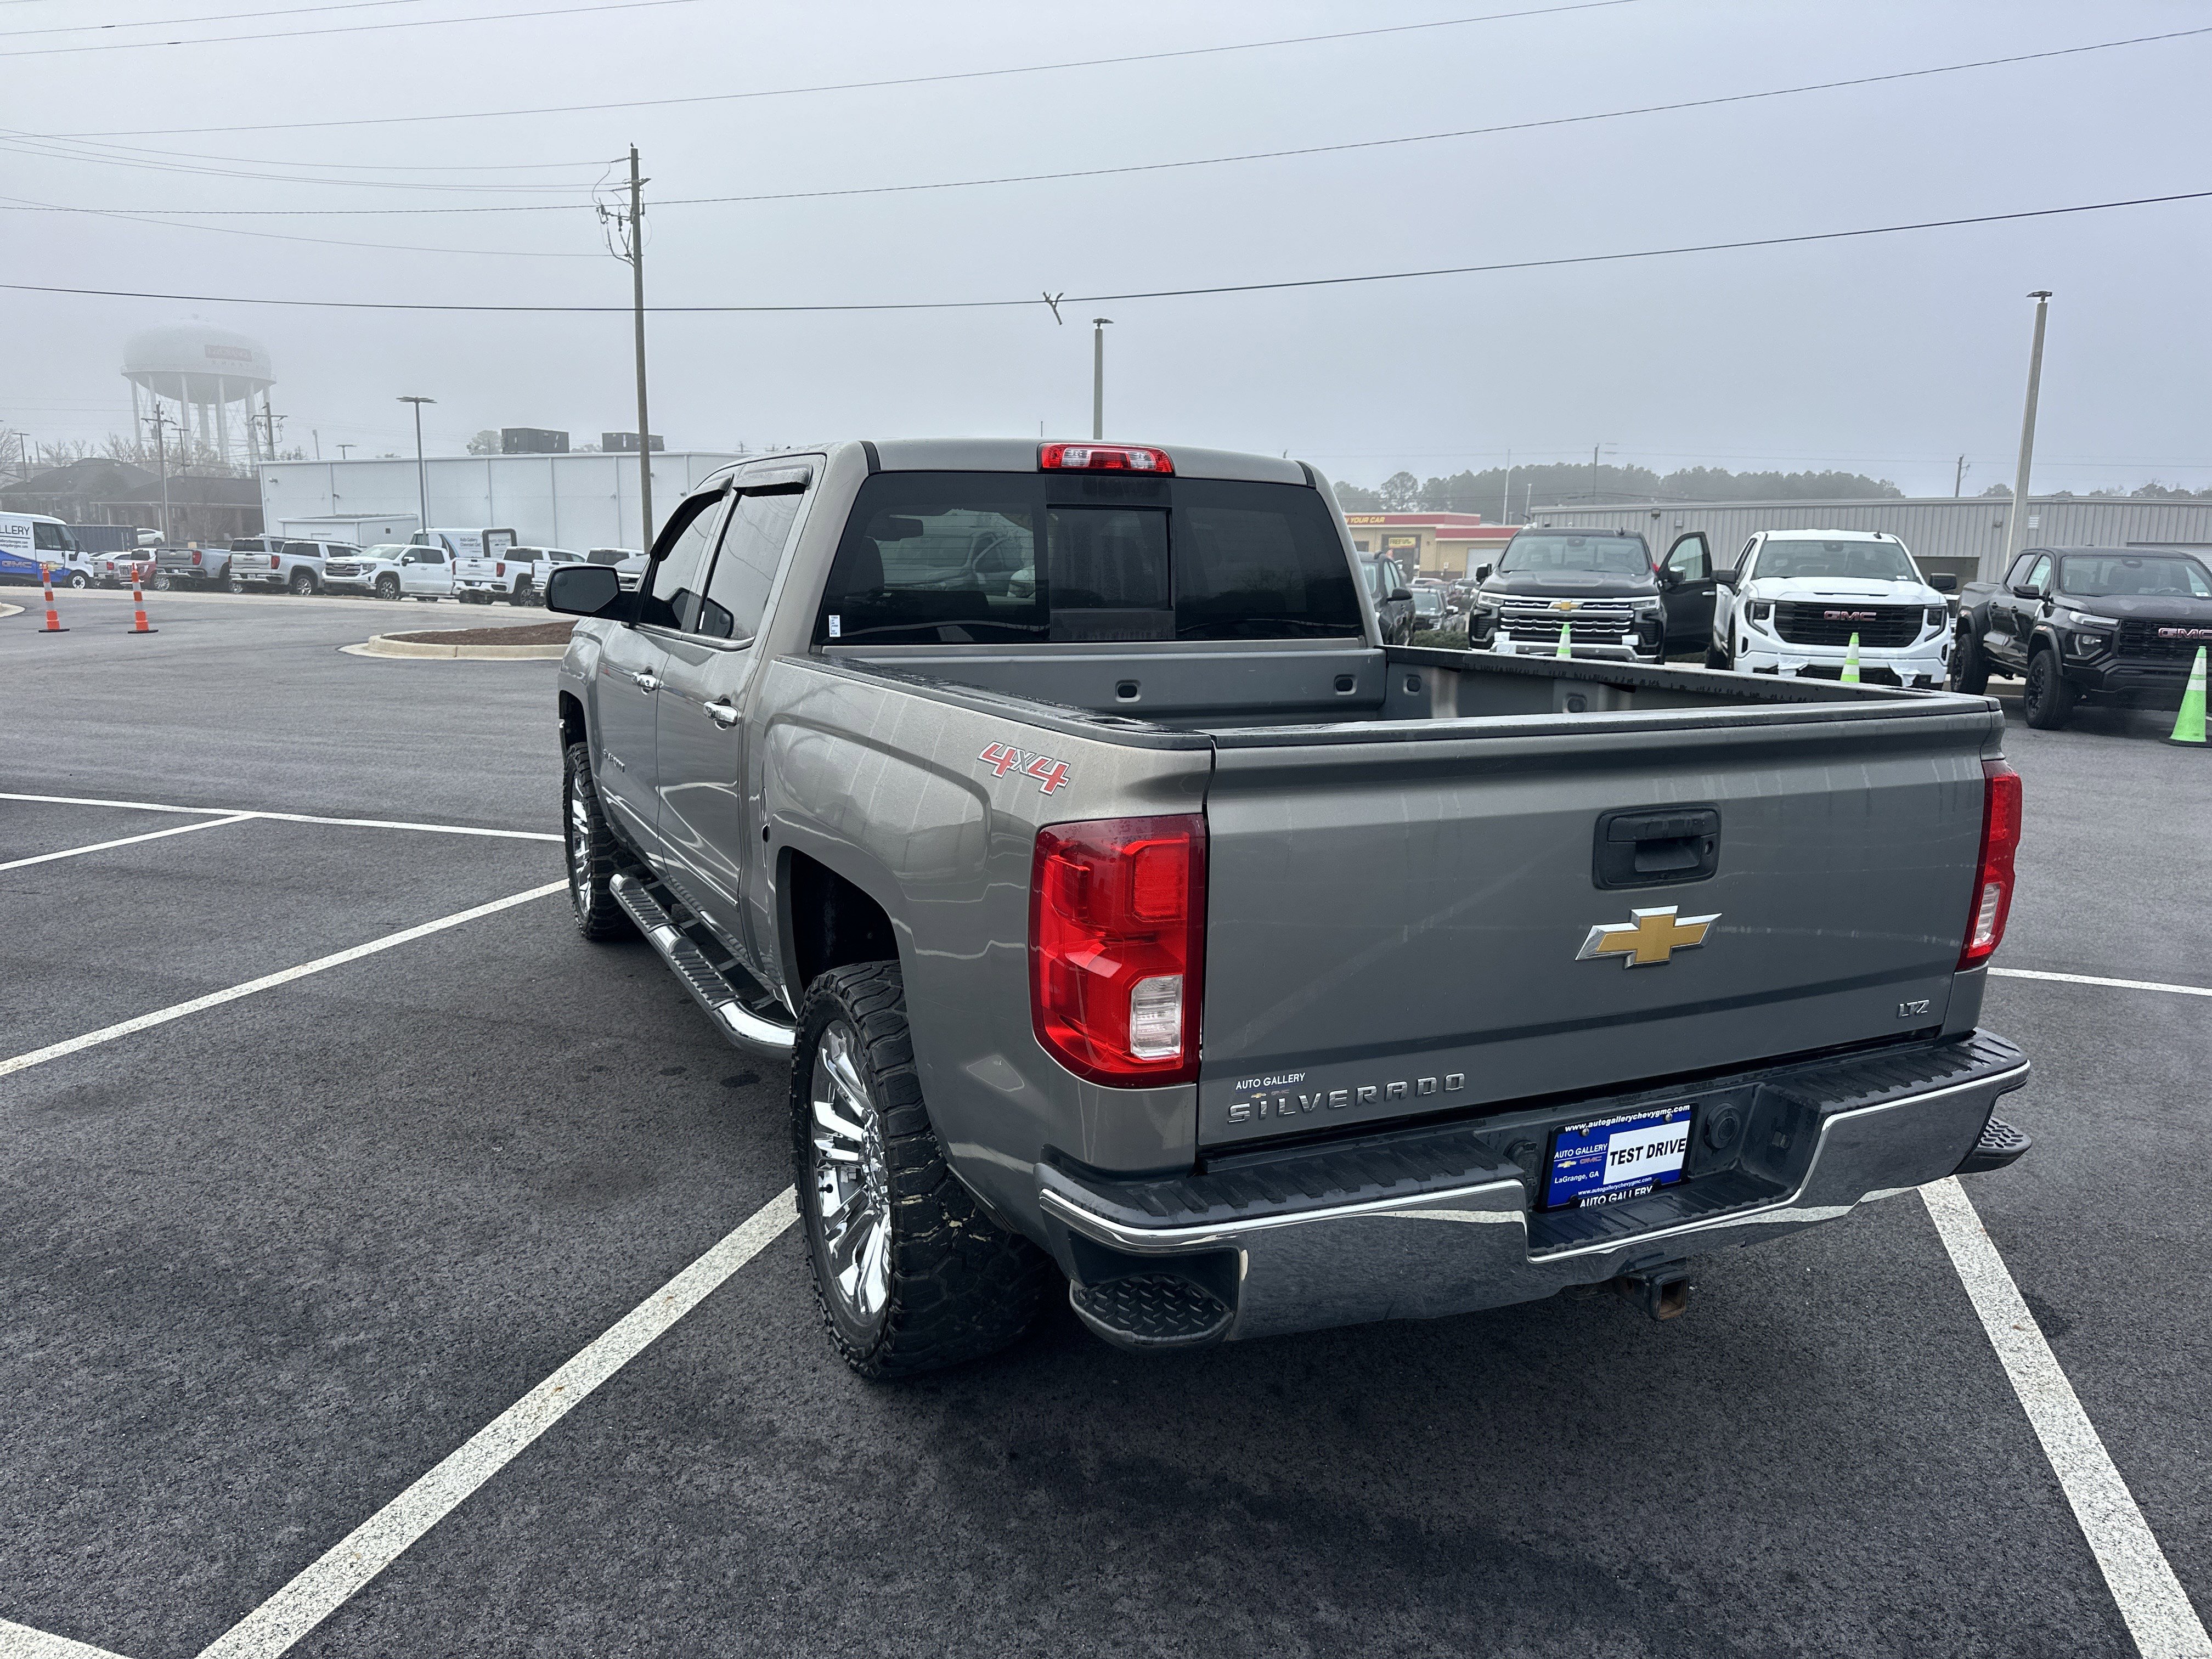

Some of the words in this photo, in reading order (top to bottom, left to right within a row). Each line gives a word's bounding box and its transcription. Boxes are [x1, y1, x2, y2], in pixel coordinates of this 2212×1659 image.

[2, 560, 32, 568] GMC
[1824, 610, 1877, 622] GMC
[2158, 628, 2212, 640] GMC
[1898, 1000, 1929, 1018] LTZ
[1235, 1079, 1261, 1090] AUTO
[1263, 1073, 1306, 1086] GALLERY
[1228, 1073, 1465, 1124] SILVERADO
[1565, 1104, 1690, 1132] www.autogallerychevygmc.com
[1554, 1149, 1574, 1160] AUTO
[1575, 1143, 1608, 1155] GALLERY
[1580, 1155, 1602, 1164] GMC
[1610, 1146, 1644, 1166] TEST
[1646, 1138, 1687, 1159] DRIVE
[1554, 1174, 1587, 1184] LaGrange,
[1589, 1170, 1599, 1178] GA
[1579, 1195, 1606, 1208] AUTO
[1608, 1185, 1653, 1203] GALLERY
